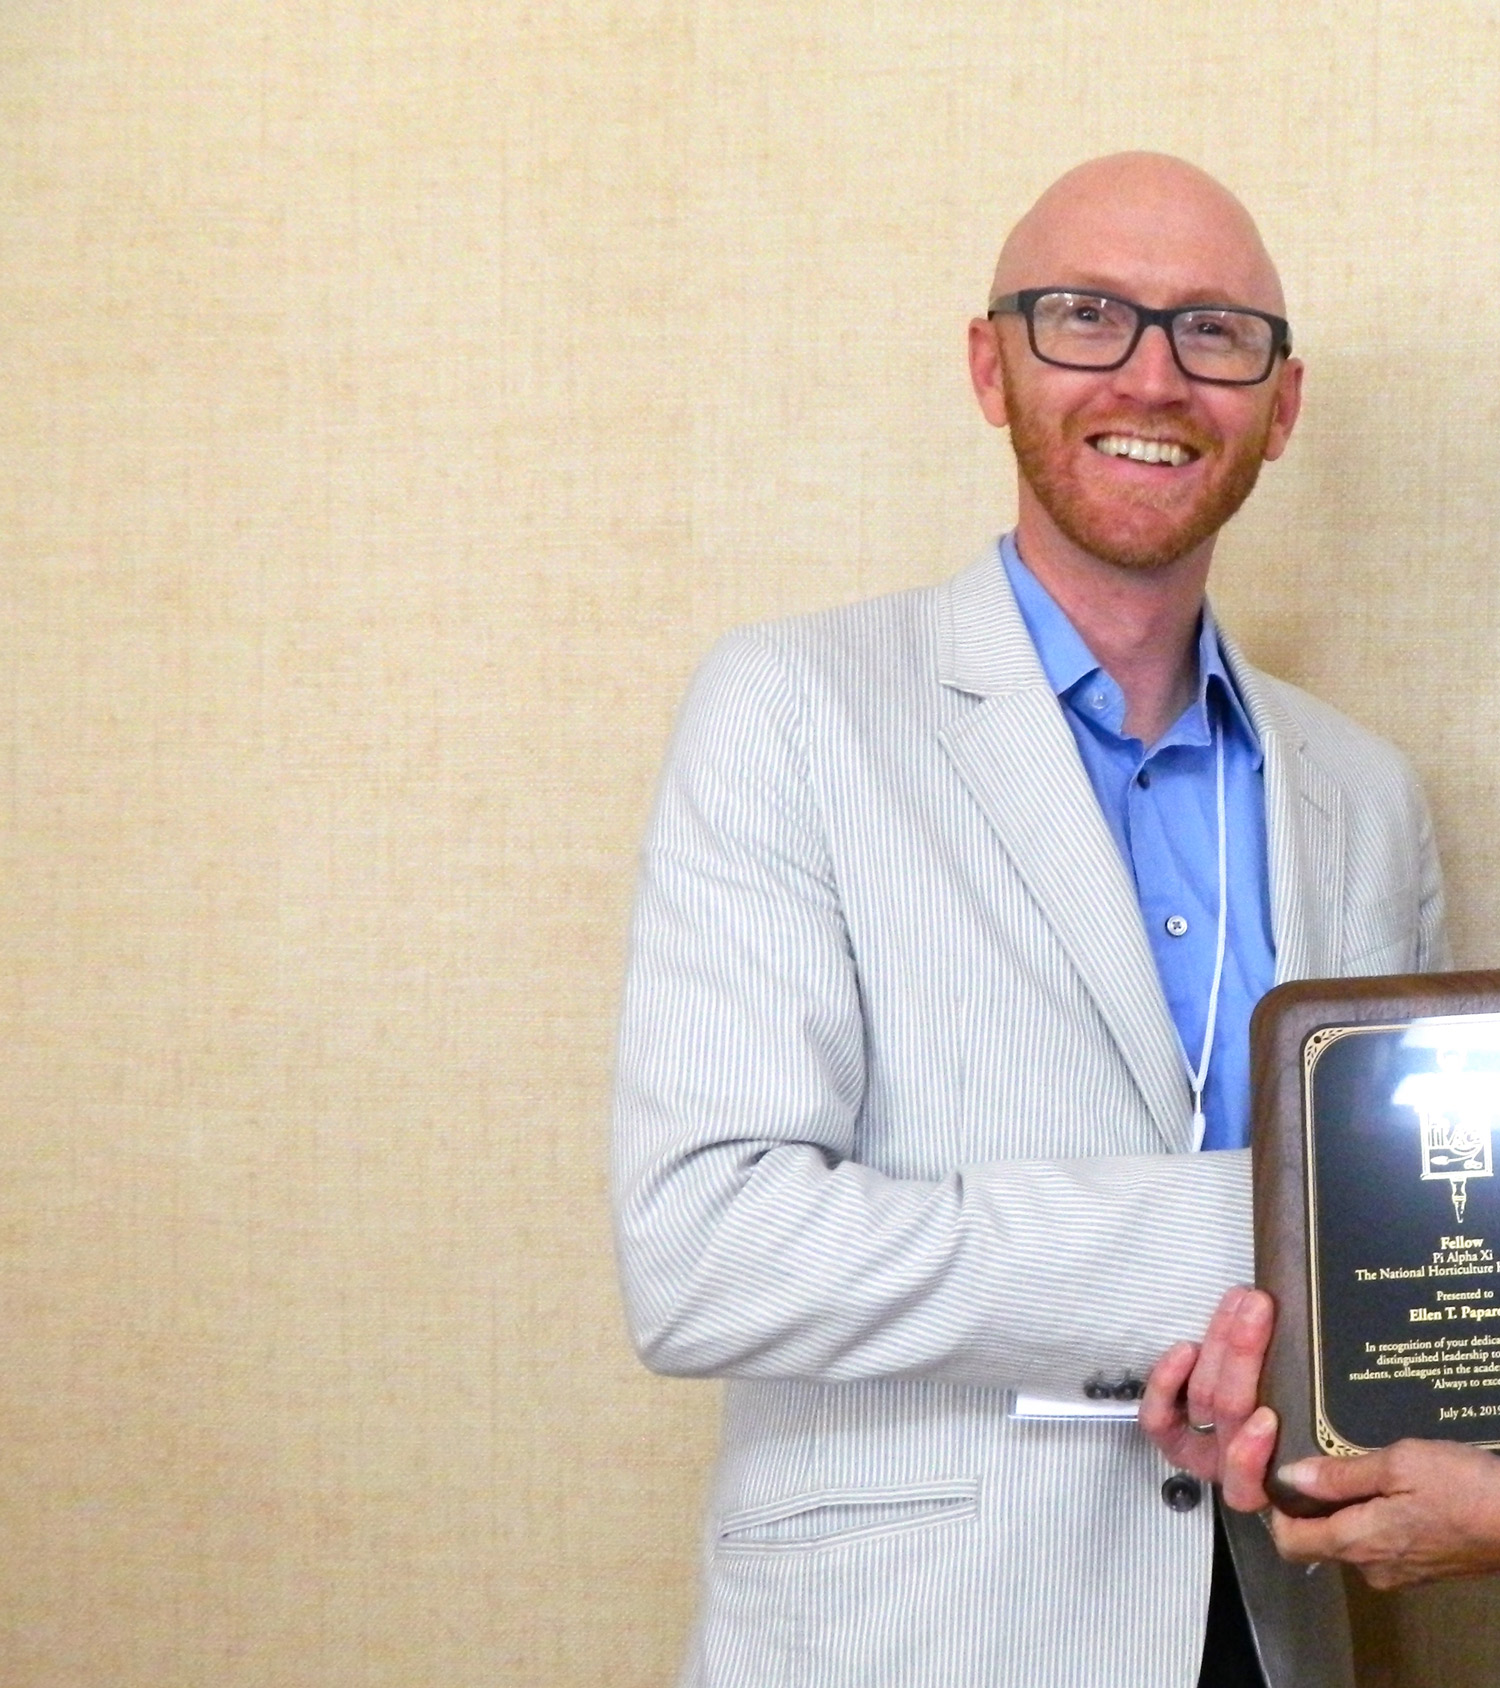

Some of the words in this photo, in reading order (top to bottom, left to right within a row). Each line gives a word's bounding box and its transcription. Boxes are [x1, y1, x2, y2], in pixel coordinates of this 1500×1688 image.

[1441, 1236, 1483, 1250] Fellow
[1433, 1252, 1444, 1263] Pi
[1447, 1252, 1477, 1265] Alpha
[1480, 1250, 1493, 1261] Xi
[1355, 1269, 1377, 1281] The
[1380, 1268, 1425, 1279] National
[1429, 1264, 1493, 1277] Horticulture
[1437, 1290, 1481, 1301] Presented
[1409, 1309, 1442, 1322] Ellen
[1445, 1307, 1458, 1320] T.
[1365, 1342, 1376, 1352] In
[1379, 1339, 1432, 1353] recognition
[1434, 1338, 1445, 1349] of
[1447, 1340, 1468, 1350] your
[1376, 1353, 1438, 1367] distinguished
[1442, 1350, 1489, 1363] leadership
[1491, 1350, 1500, 1358] to
[1349, 1369, 1391, 1382] students,
[1394, 1367, 1441, 1381] colleagues
[1443, 1366, 1454, 1375] in
[1456, 1366, 1471, 1375] the
[1470, 1379, 1480, 1387] to
[1439, 1407, 1459, 1421] July
[1461, 1406, 1477, 1418] 24,
